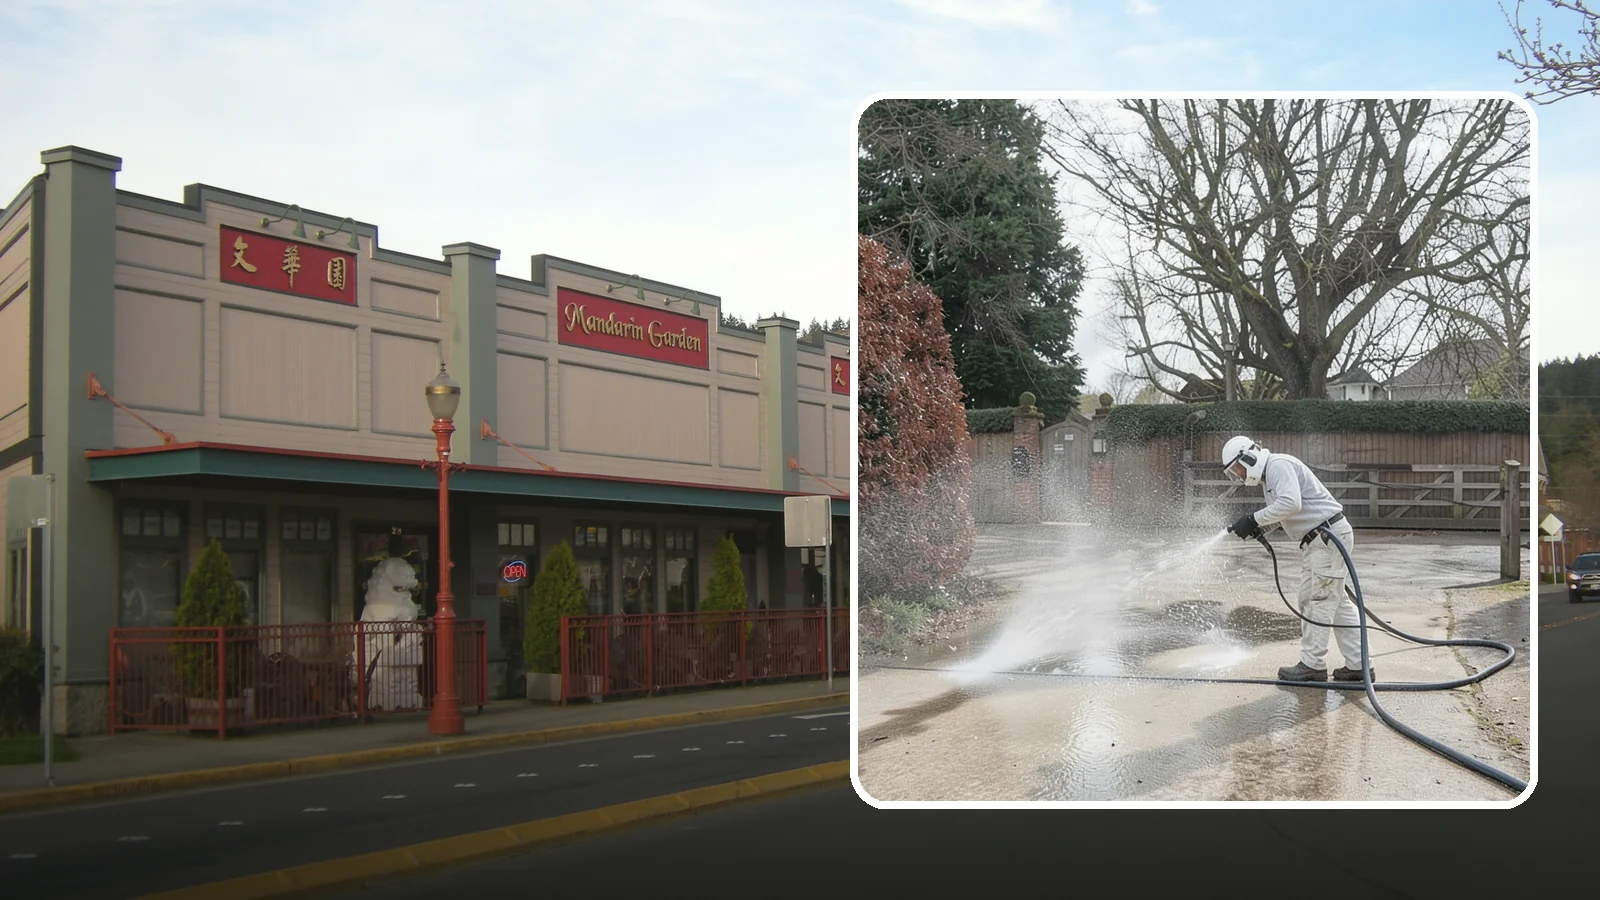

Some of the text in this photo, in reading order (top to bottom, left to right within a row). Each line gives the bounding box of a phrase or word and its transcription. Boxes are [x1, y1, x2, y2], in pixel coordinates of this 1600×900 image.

[231, 236, 346, 291] 文華園
[564, 302, 701, 352] Mandarin Garden
[503, 565, 527, 578] OPEN
